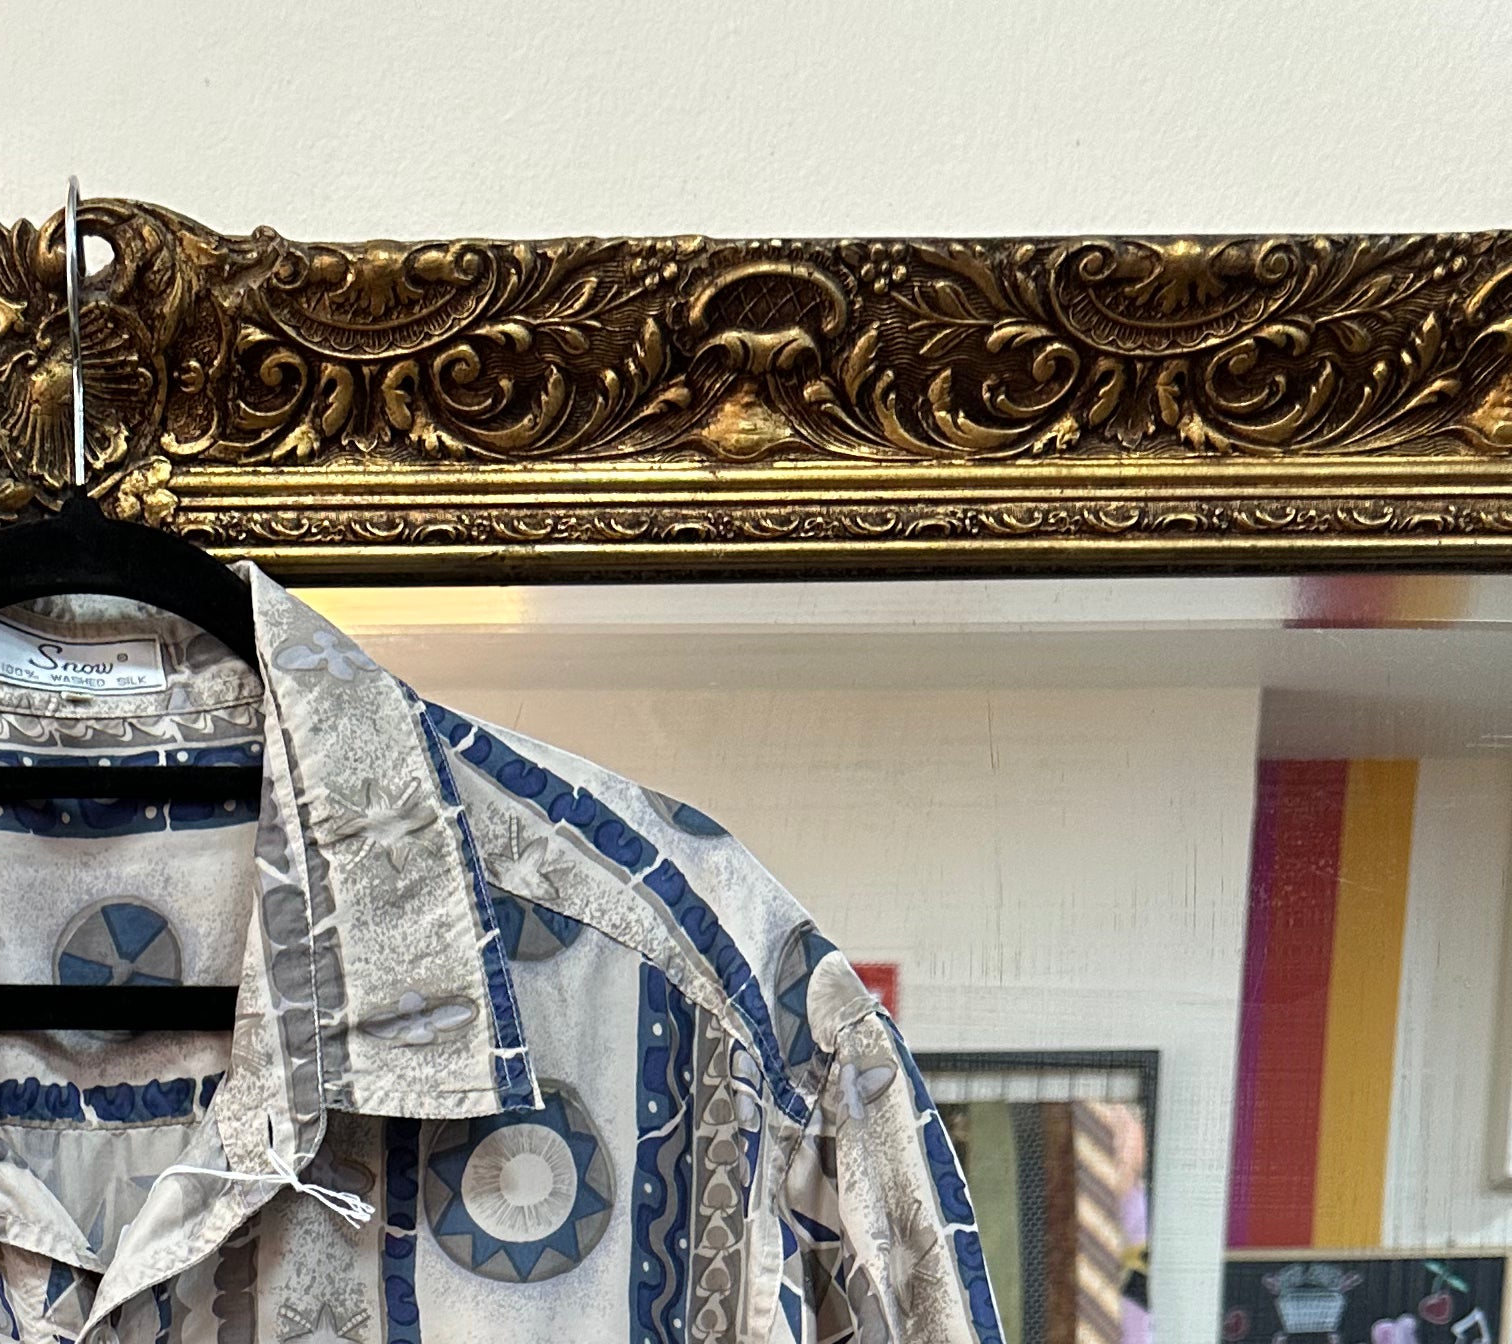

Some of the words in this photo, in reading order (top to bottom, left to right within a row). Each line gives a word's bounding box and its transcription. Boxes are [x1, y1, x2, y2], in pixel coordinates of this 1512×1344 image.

[28, 644, 114, 675] Snow
[0, 662, 40, 680] 100%
[50, 674, 106, 687] WASHED
[116, 675, 147, 687] SILK
